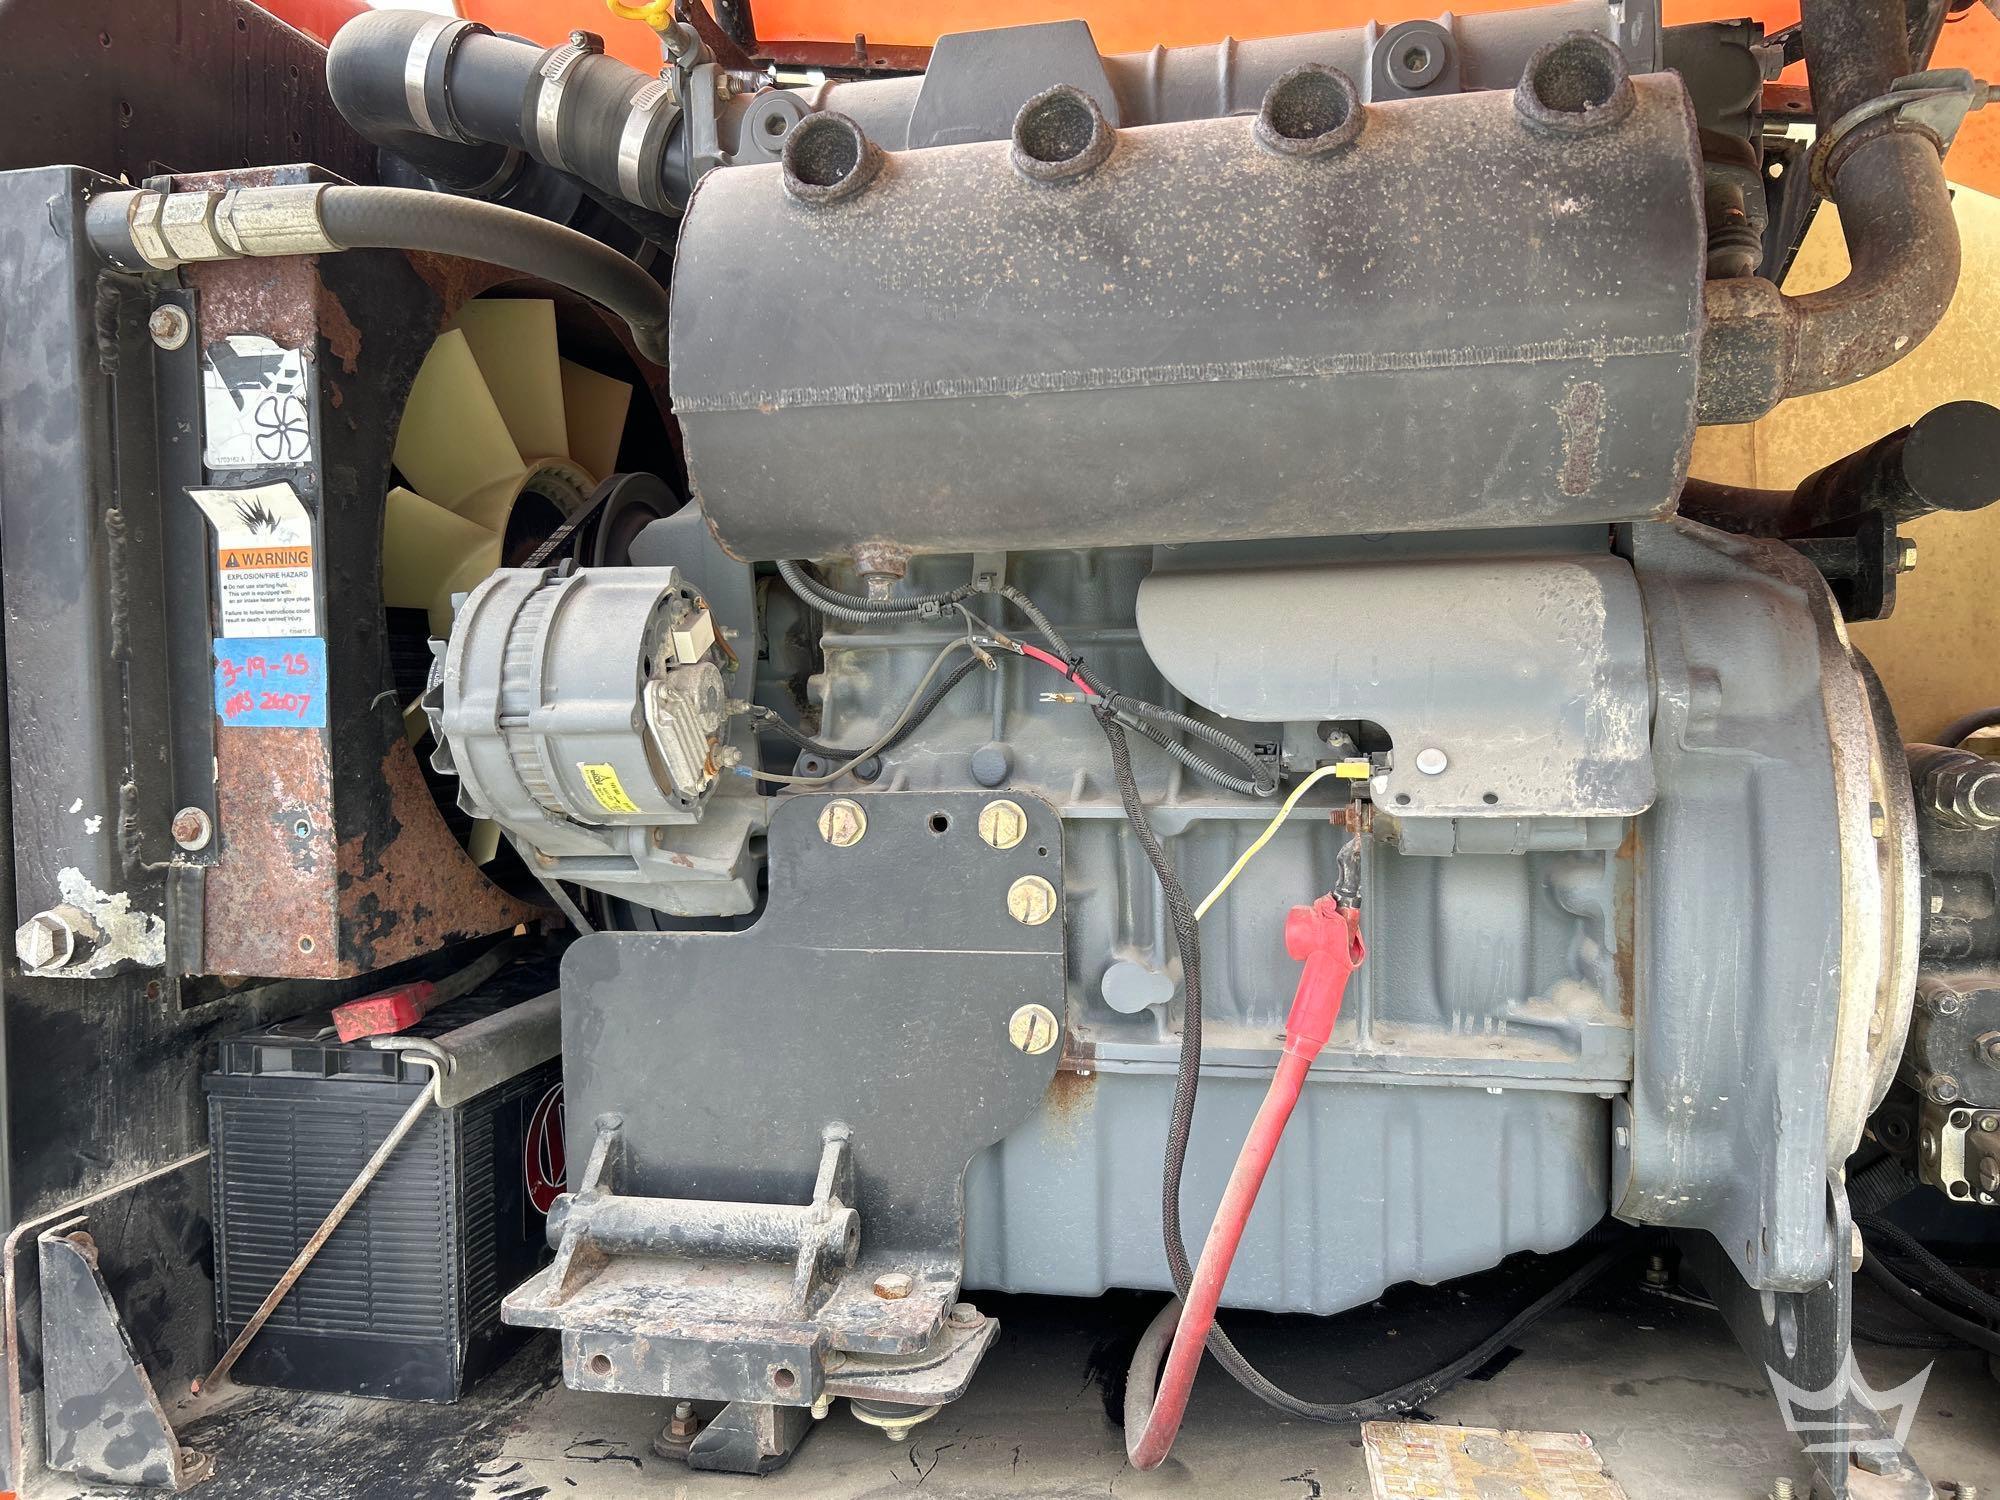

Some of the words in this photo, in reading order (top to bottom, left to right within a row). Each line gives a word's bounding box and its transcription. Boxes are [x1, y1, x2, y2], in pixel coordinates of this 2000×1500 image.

[242, 551, 309, 566] WARNING
[227, 571, 280, 580] EXPLOSION/FIRE
[281, 570, 309, 578] HAZARD
